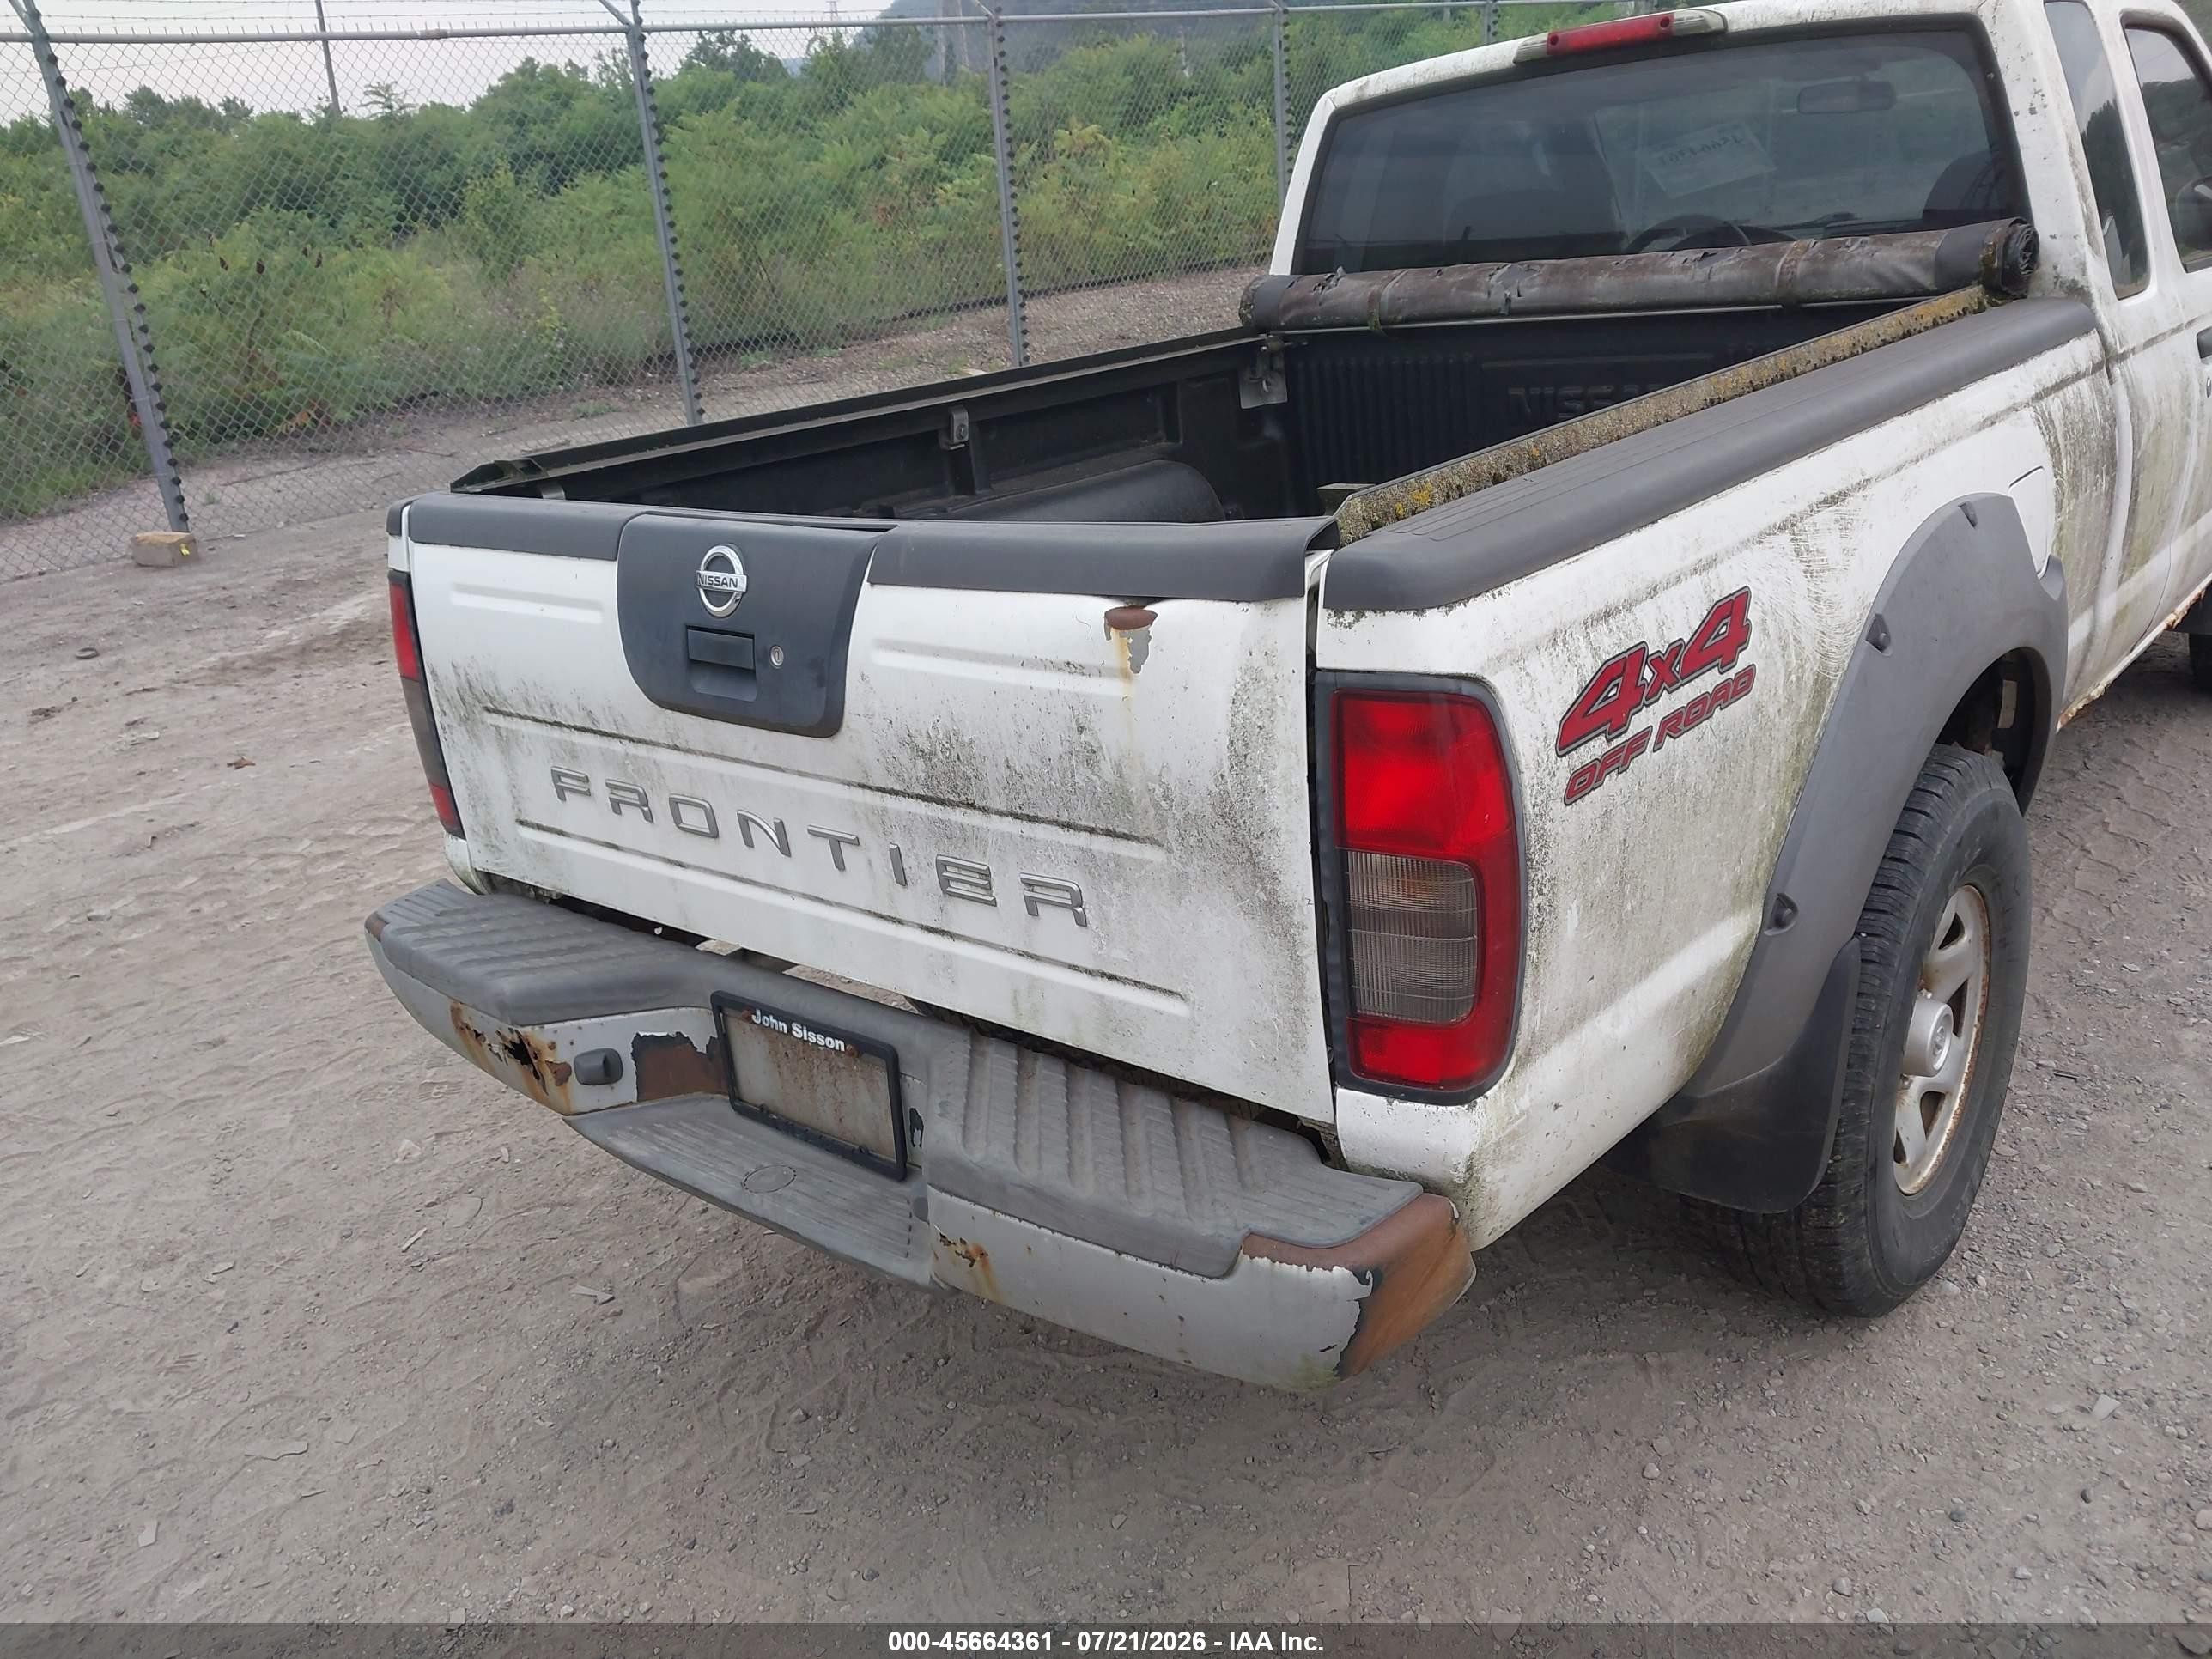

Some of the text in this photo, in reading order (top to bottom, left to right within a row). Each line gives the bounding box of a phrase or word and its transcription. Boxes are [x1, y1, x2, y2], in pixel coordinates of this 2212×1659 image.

[696, 572, 738, 588] NISSAN
[1555, 586, 1752, 757] 4x4
[1564, 664, 1756, 806] OFF ROAD
[551, 766, 1087, 927] FRONTIER
[751, 1009, 845, 1051] John Sisson
